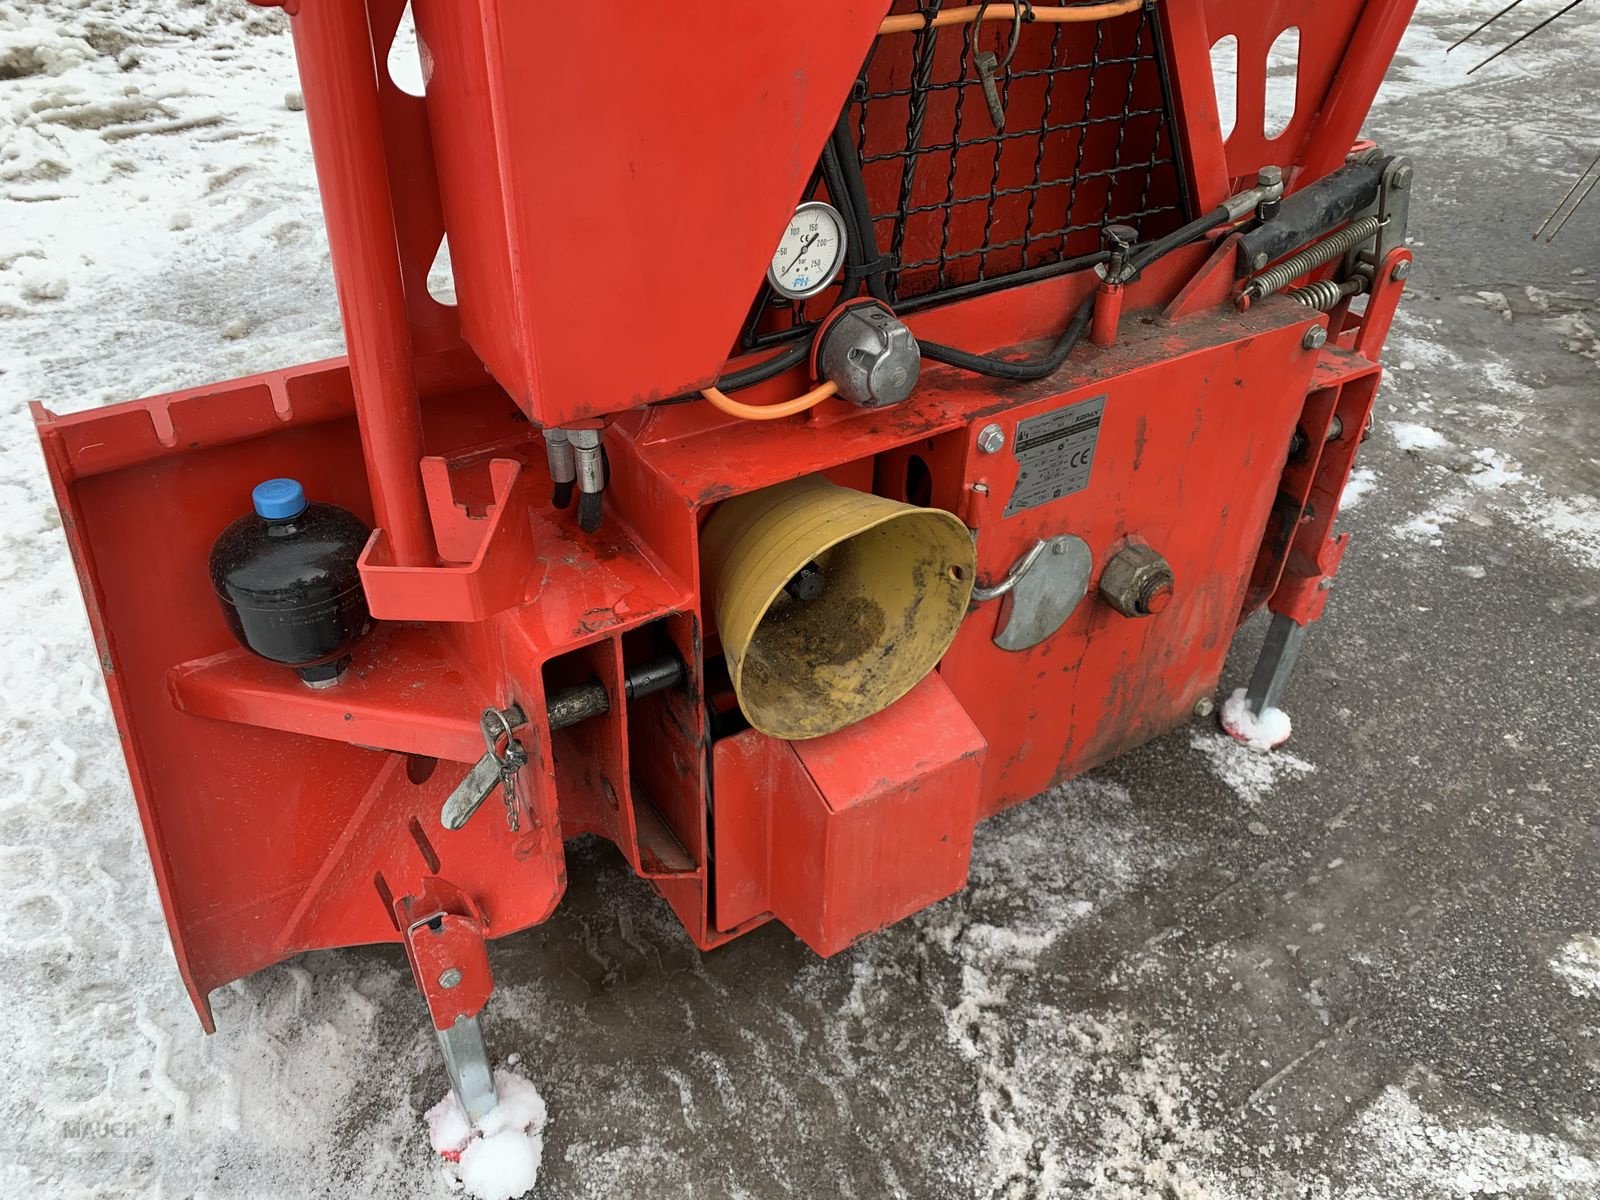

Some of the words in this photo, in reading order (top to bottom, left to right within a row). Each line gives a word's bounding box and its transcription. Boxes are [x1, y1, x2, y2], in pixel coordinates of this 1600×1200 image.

[790, 227, 800, 236] 100
[809, 223, 818, 232] 150
[817, 239, 827, 247] 200
[780, 248, 787, 256] 50
[811, 259, 821, 268] 250
